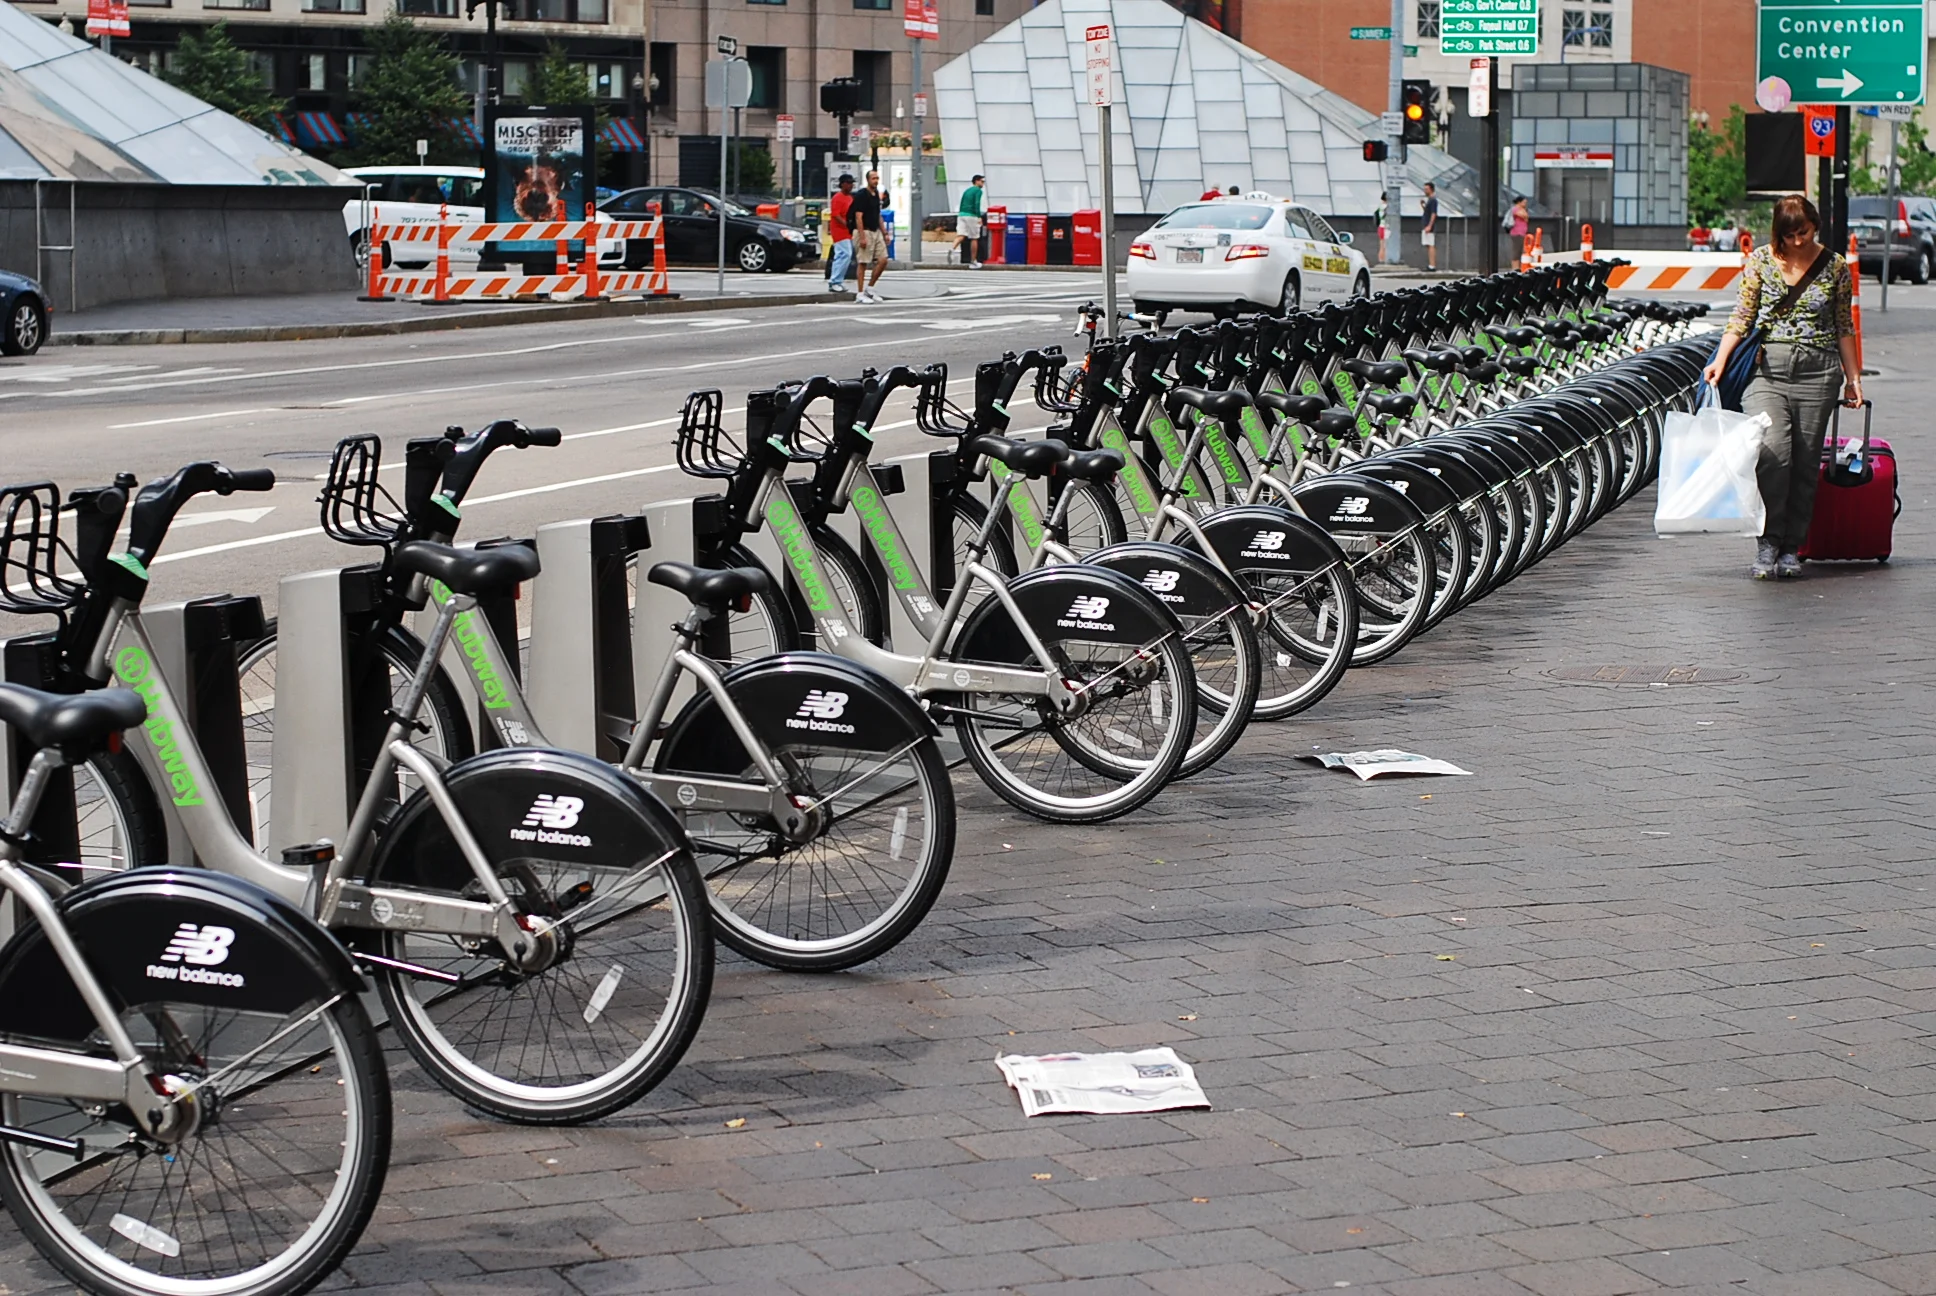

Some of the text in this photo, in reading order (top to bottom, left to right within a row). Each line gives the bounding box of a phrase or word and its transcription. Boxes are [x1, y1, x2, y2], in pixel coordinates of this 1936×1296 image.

[1496, 0, 1518, 10] Center
[1504, 20, 1516, 31] Hall
[1518, 20, 1529, 31] 0.7
[1778, 16, 1905, 33] Convention
[1094, 44, 1101, 53] NO
[1479, 40, 1530, 50] Park Street 0.6
[1777, 42, 1852, 59] Center
[1087, 57, 1109, 70] STOPPING
[1880, 104, 1911, 115] ON RED
[498, 125, 578, 138] MISCHIEF
[1813, 119, 1831, 133] 93
[1205, 423, 1242, 484] Hubway
[1159, 433, 1200, 498] Hubay
[1009, 481, 1044, 548] ubway
[1344, 515, 1373, 523] balance
[864, 507, 917, 591] Hubway
[1240, 550, 1289, 560] new balance
[778, 523, 834, 612] Hubway
[1057, 618, 1114, 631] new balance
[786, 718, 854, 734] new balance
[510, 828, 591, 847] new balance
[146, 964, 244, 987] new balance
